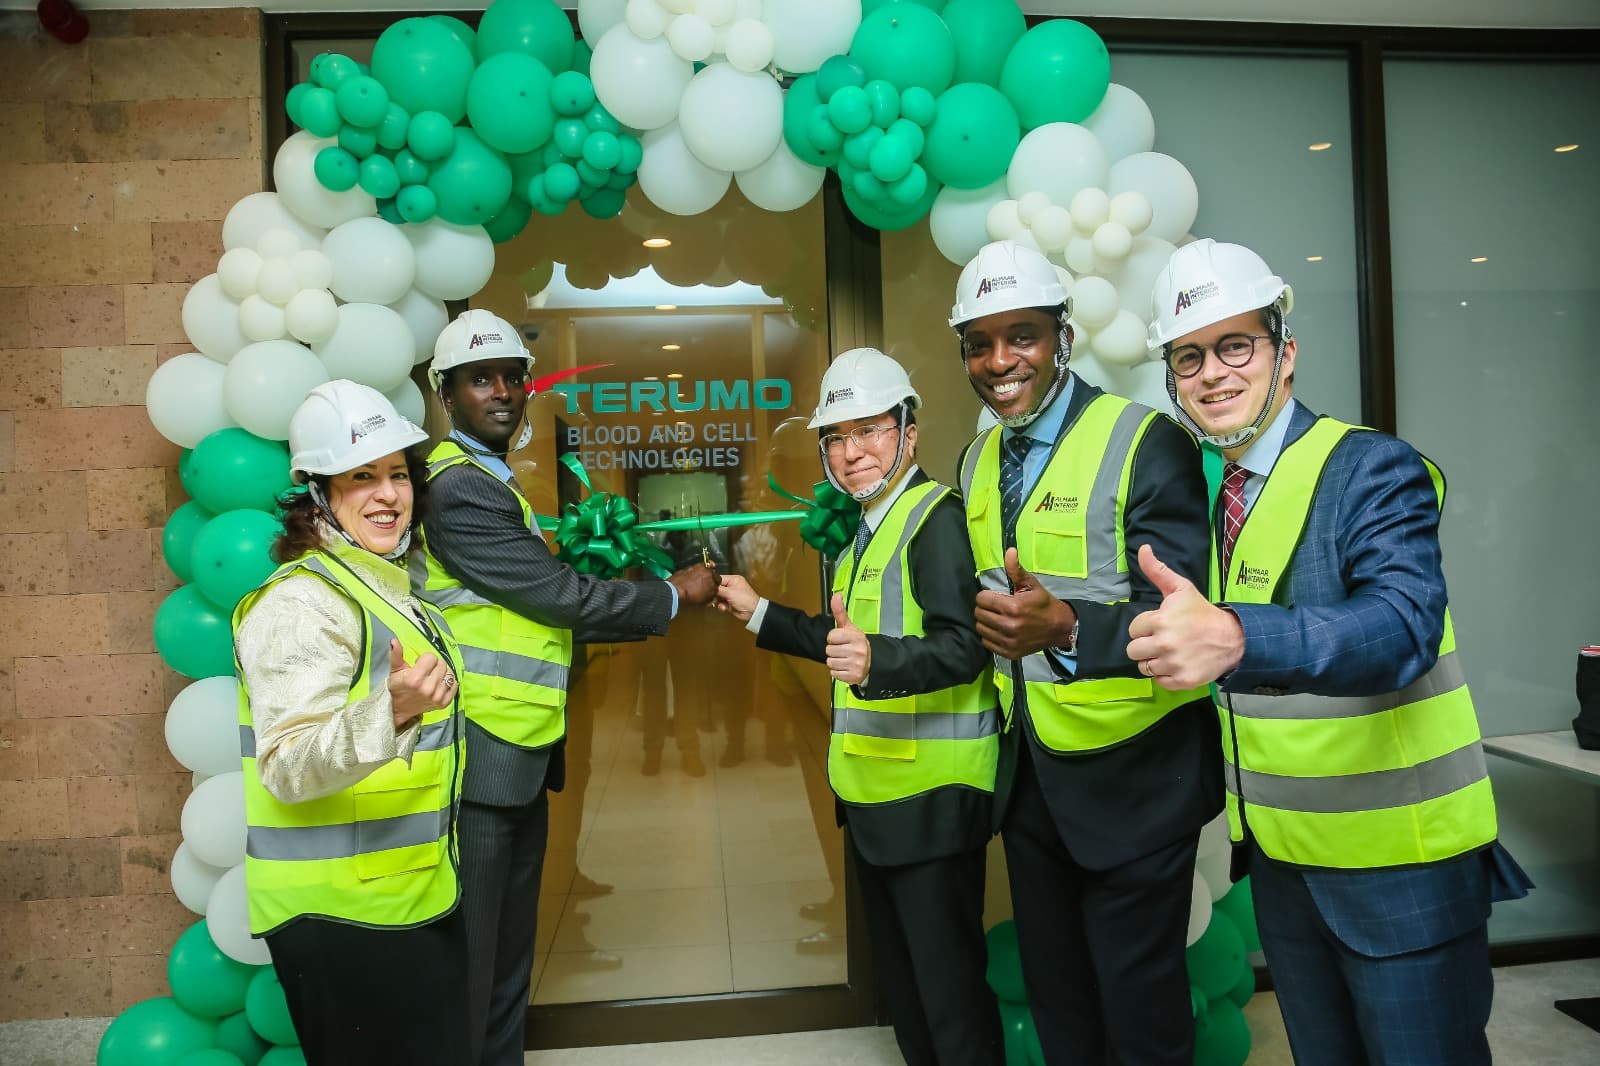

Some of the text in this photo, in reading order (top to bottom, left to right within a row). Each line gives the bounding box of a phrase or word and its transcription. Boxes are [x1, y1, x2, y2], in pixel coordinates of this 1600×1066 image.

[1189, 281, 1215, 294] ALMAAR
[1190, 286, 1219, 299] INTERIOR
[553, 378, 791, 414] TERUMO
[567, 422, 758, 446] BLOOD AND CELL
[1248, 566, 1270, 576] ALMAAR
[1246, 574, 1270, 585] INTERIOR
